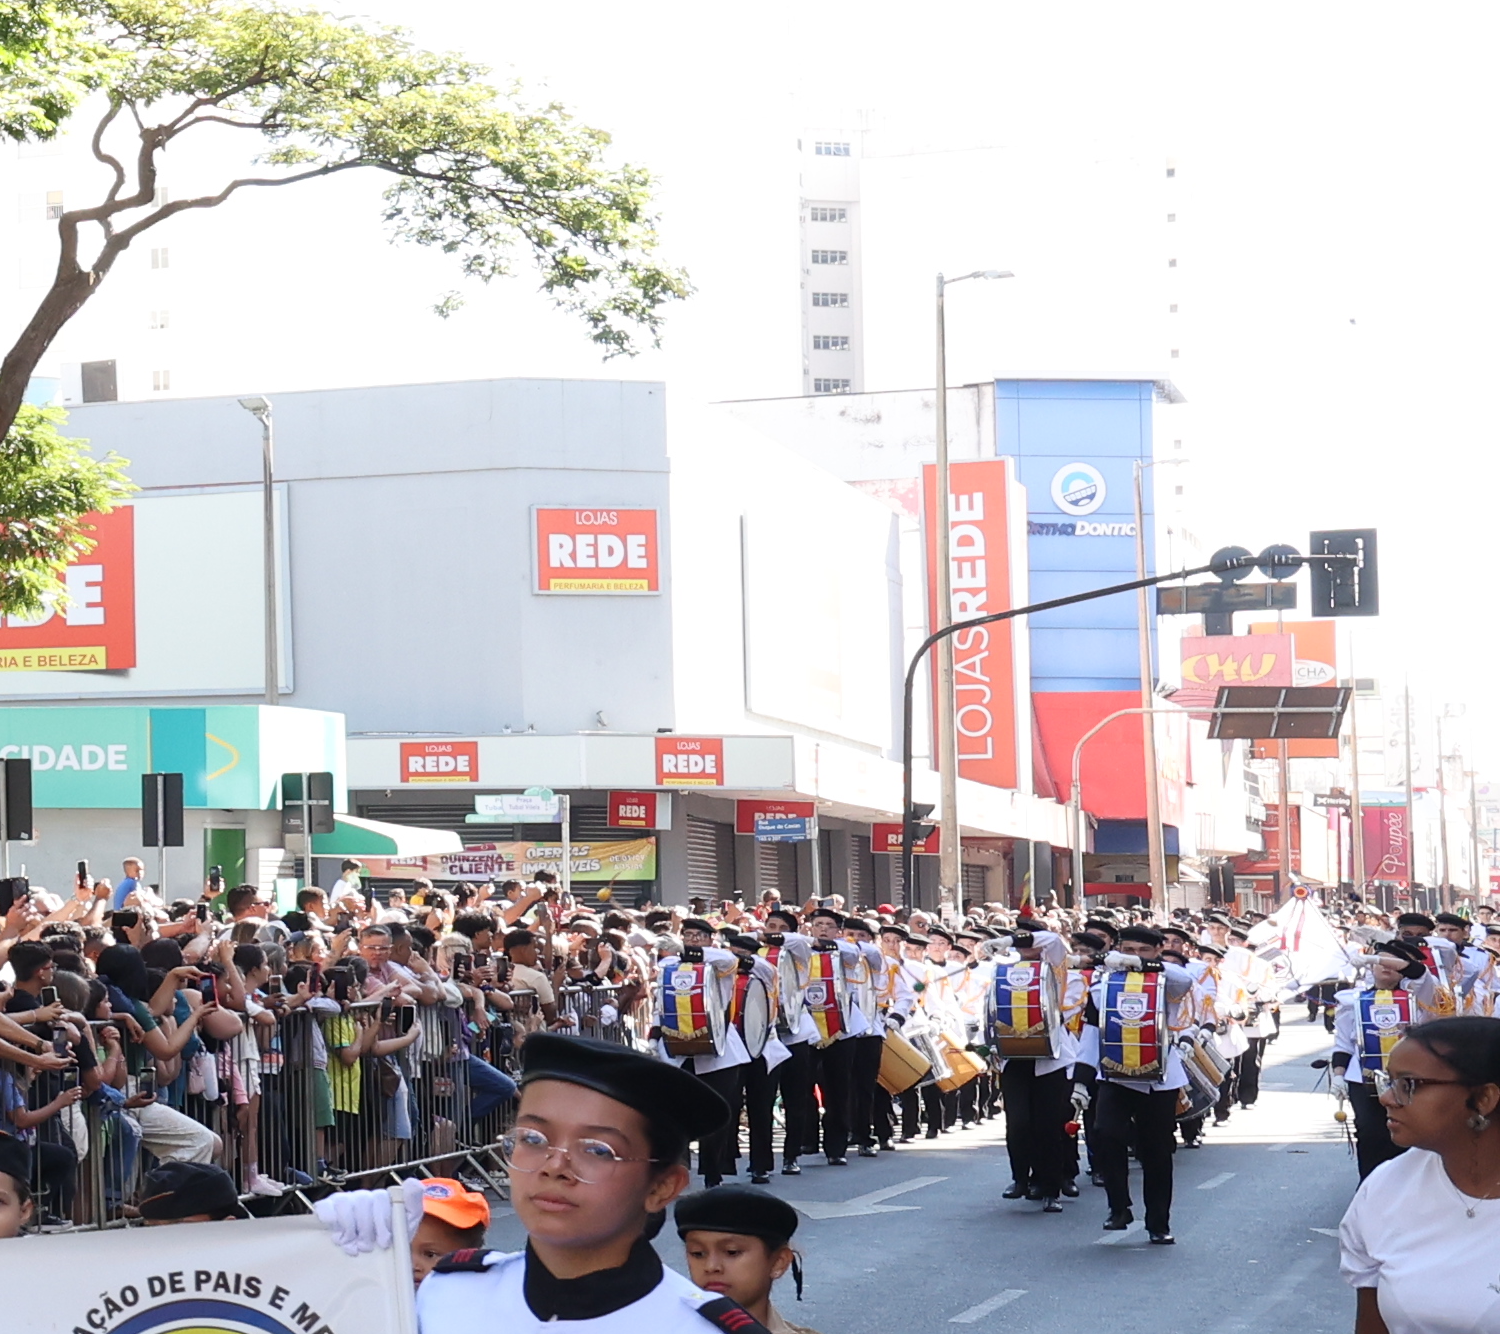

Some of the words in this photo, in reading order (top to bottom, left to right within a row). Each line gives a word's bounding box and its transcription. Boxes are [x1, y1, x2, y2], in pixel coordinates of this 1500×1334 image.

[575, 511, 618, 525] LOJAS
[548, 533, 648, 569] REDE
[950, 491, 989, 624] REDE
[553, 582, 605, 590] PERFUMARIA
[613, 583, 645, 591] BELEZA
[22, 655, 32, 667] E
[37, 653, 99, 667] BELEZA
[953, 623, 994, 760] LOJAS
[425, 744, 453, 753] LOJAS
[676, 742, 701, 750] LOJAS
[408, 755, 470, 773] REDE
[662, 754, 717, 774] REDE
[618, 805, 646, 818] REDE
[1382, 812, 1409, 873] Poupée
[440, 853, 504, 865] QUINZENA
[526, 845, 591, 859] OFERAS
[449, 860, 515, 875] CLIENTE
[146, 1270, 187, 1299] DE
[193, 1268, 263, 1299] PAIS
[267, 1284, 291, 1311] E
